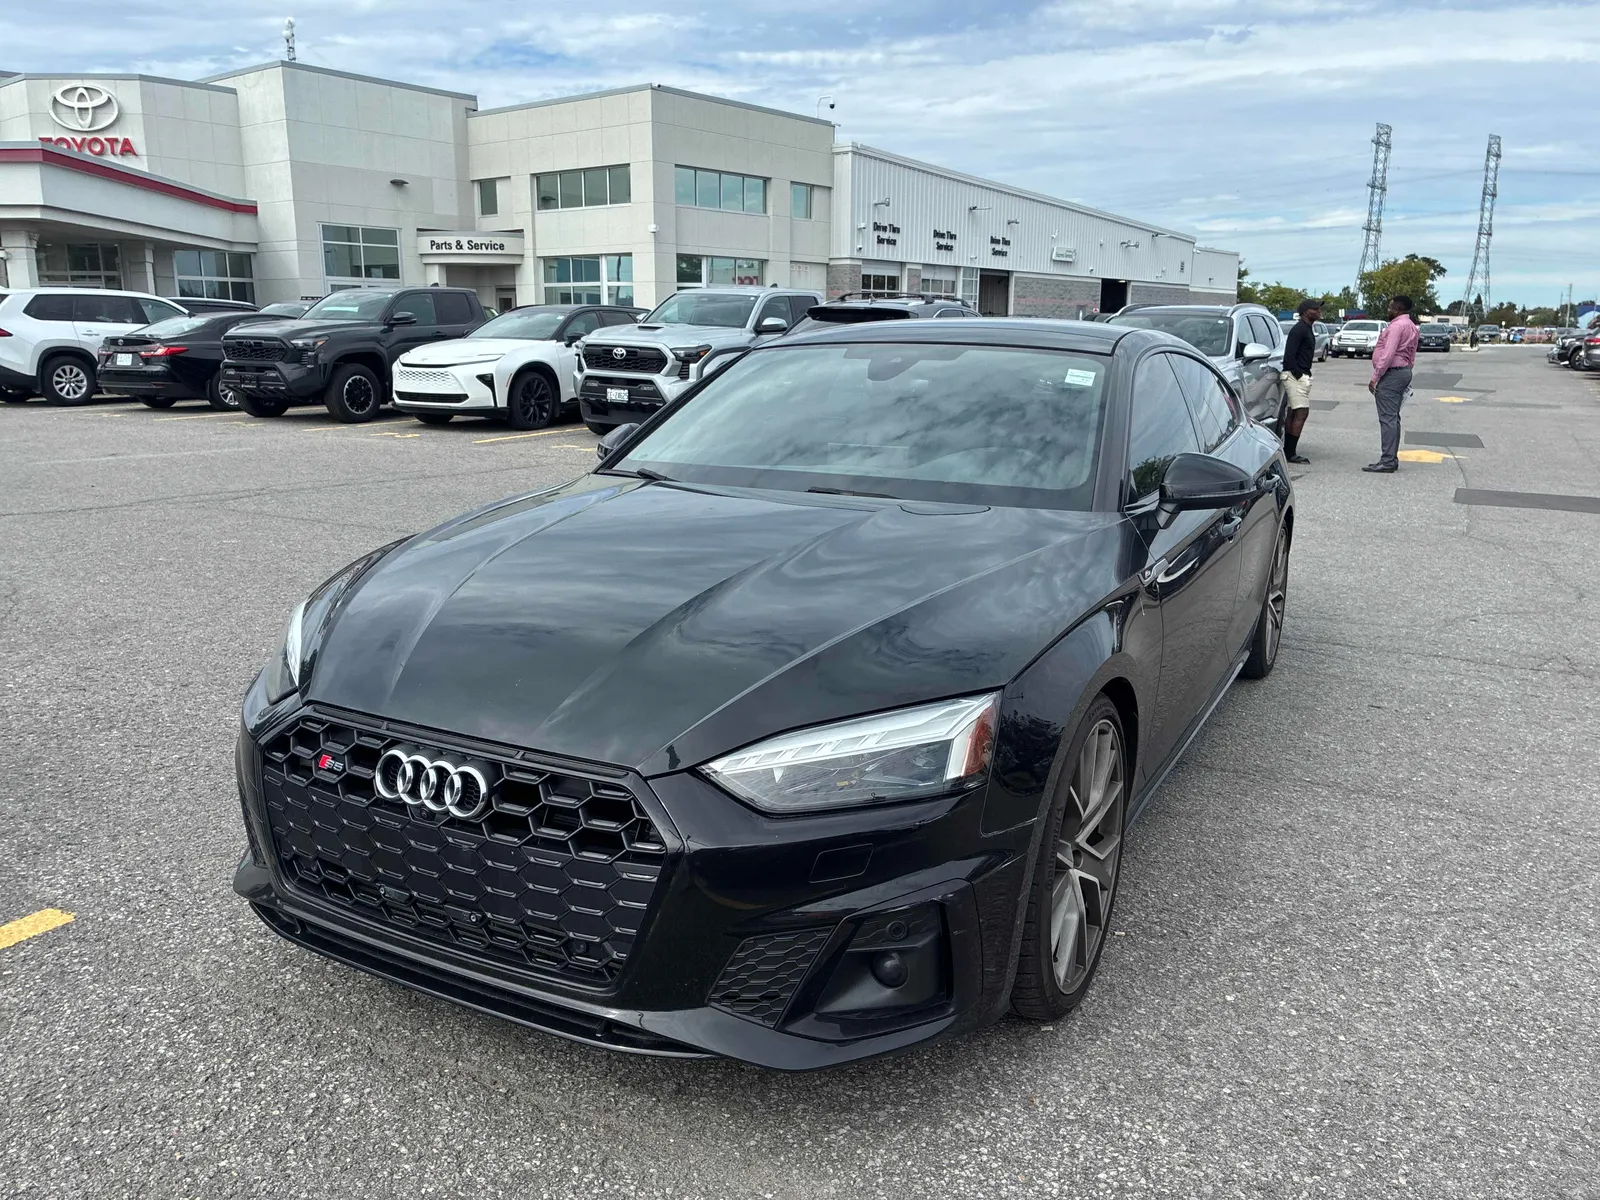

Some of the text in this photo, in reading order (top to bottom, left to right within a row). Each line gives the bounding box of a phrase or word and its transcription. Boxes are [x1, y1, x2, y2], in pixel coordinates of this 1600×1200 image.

[873, 221, 901, 234] Drive Thru
[430, 240, 505, 251] Parts & Service
[876, 234, 897, 246] Service
[936, 241, 954, 252] Service
[322, 757, 344, 772] S5
